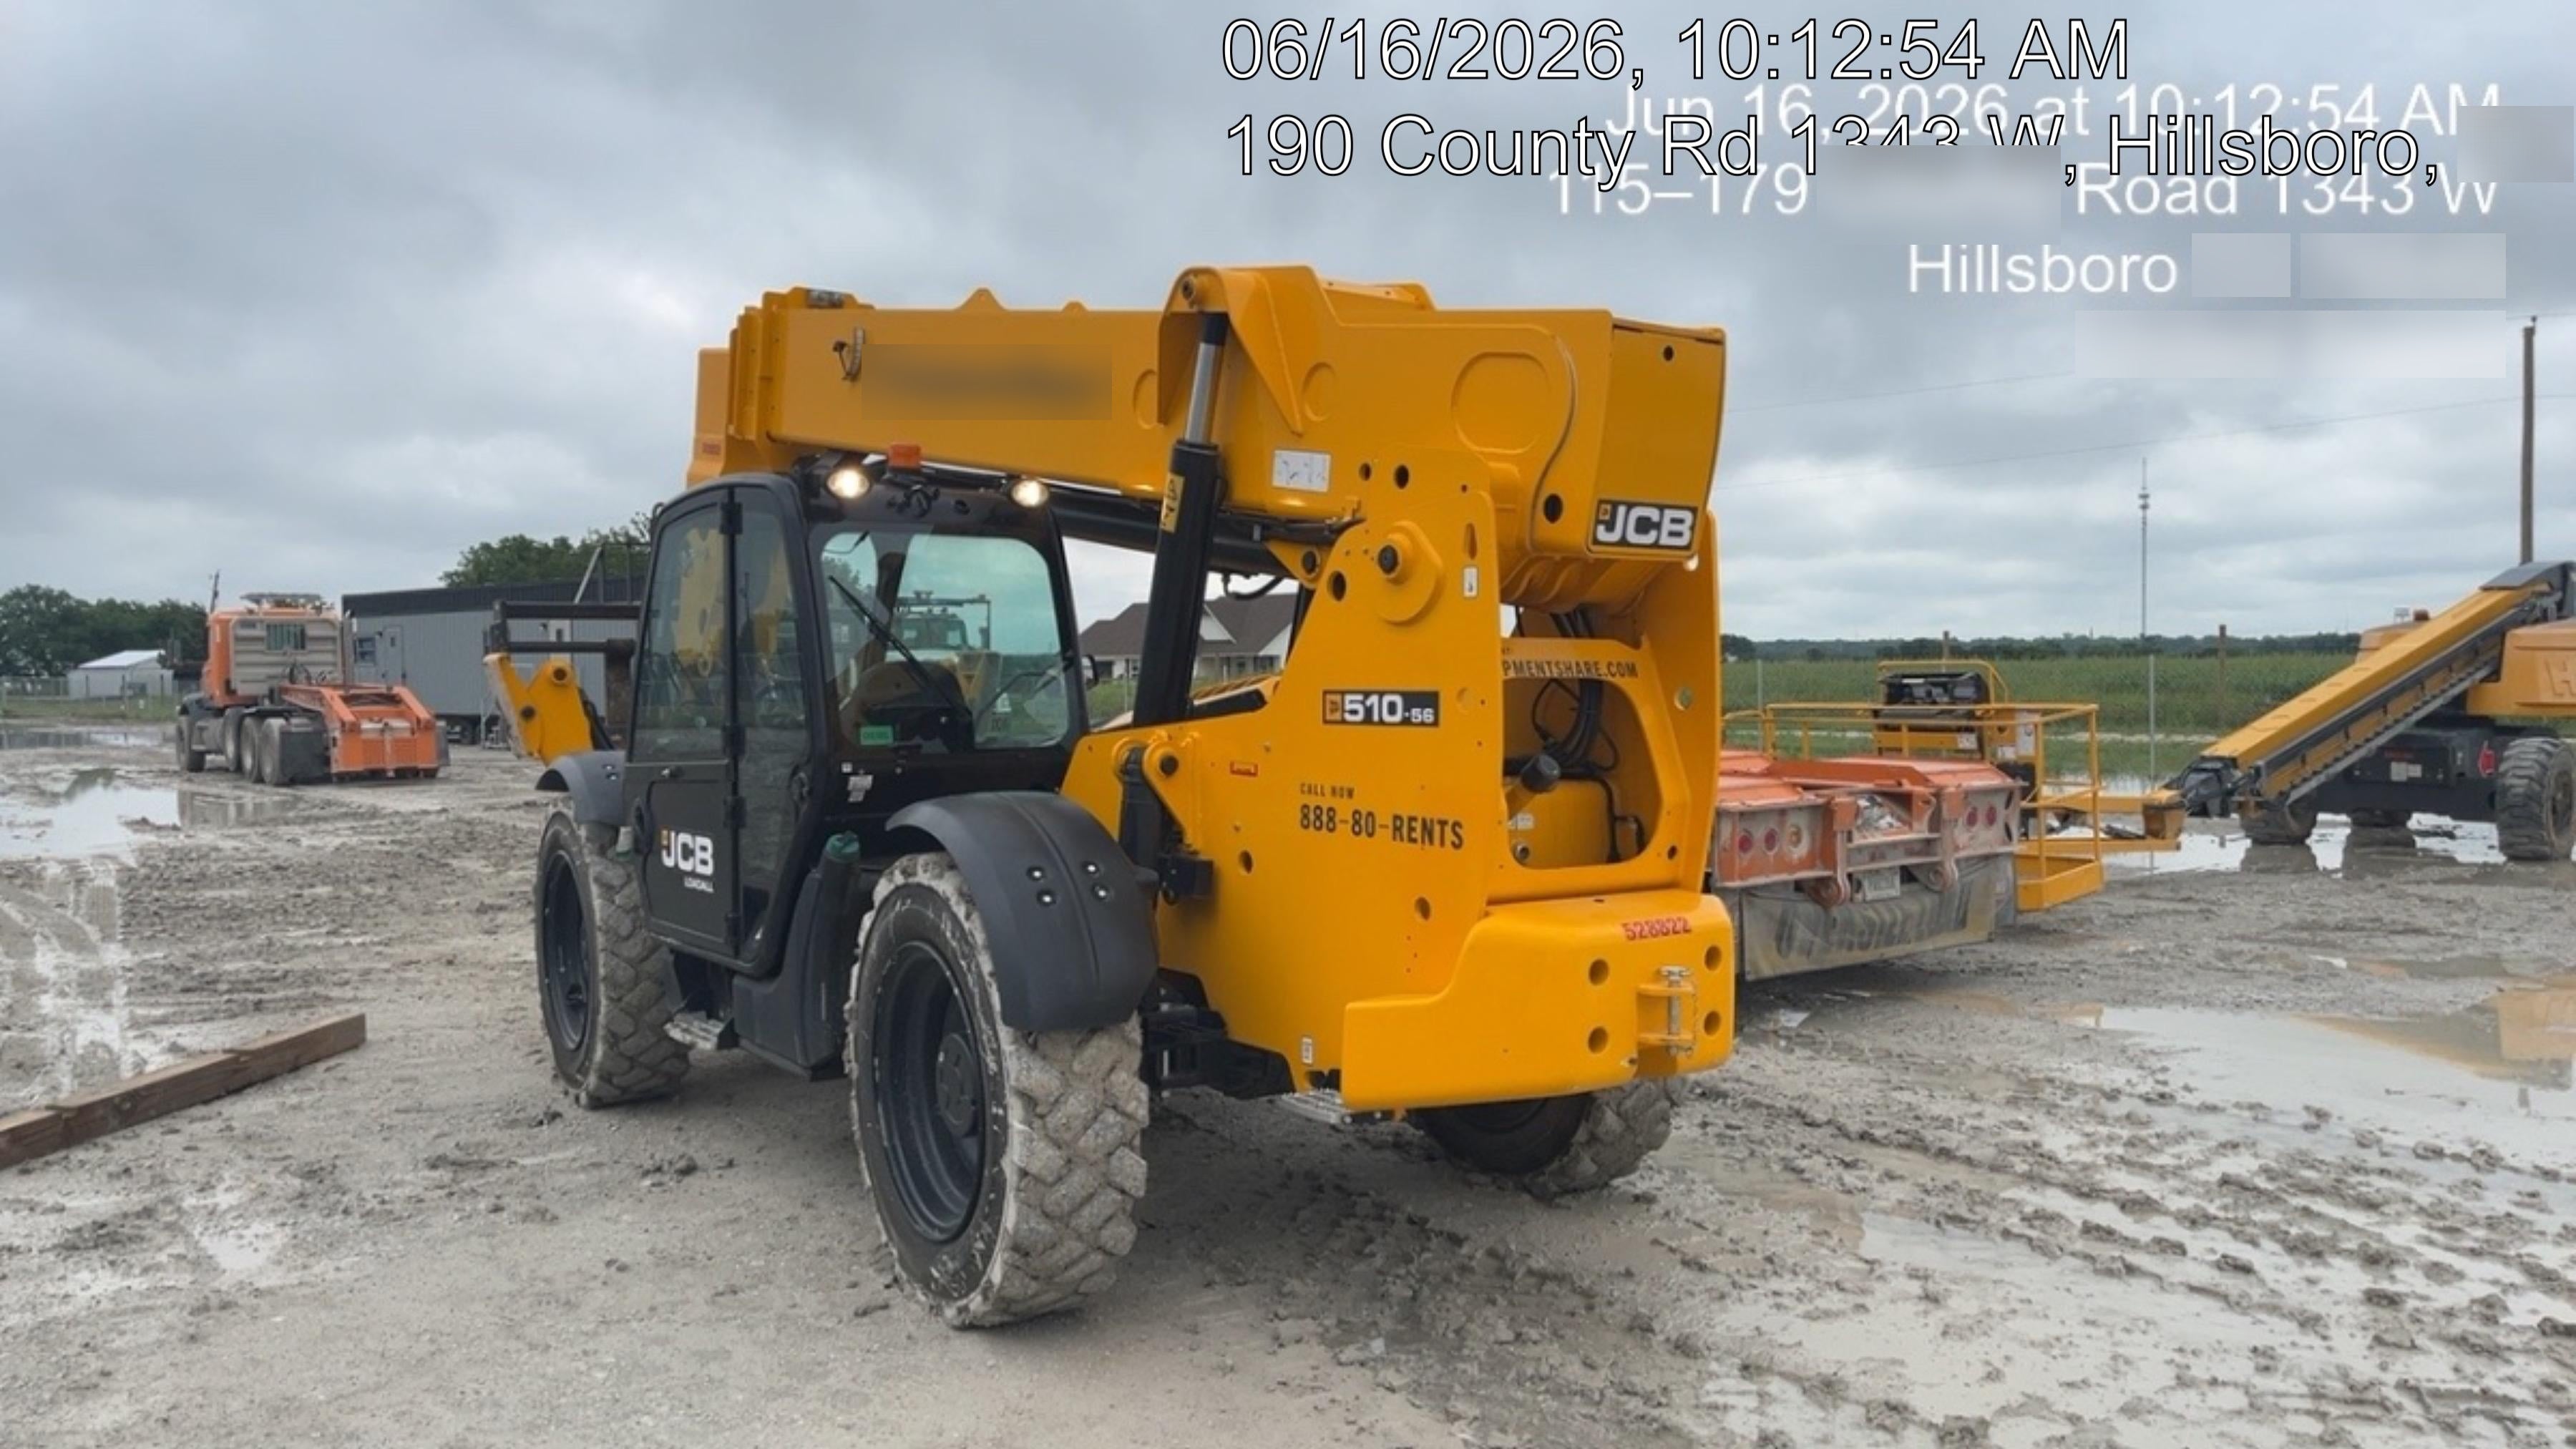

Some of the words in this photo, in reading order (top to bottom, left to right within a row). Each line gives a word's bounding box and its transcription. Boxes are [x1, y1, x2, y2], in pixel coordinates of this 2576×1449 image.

[1596, 504, 1694, 547] JCB
[1299, 782, 1326, 797] CALL
[1331, 785, 1355, 800] NOW
[1299, 803, 1463, 850] 888-80-RENTS
[660, 829, 714, 876] JCB
